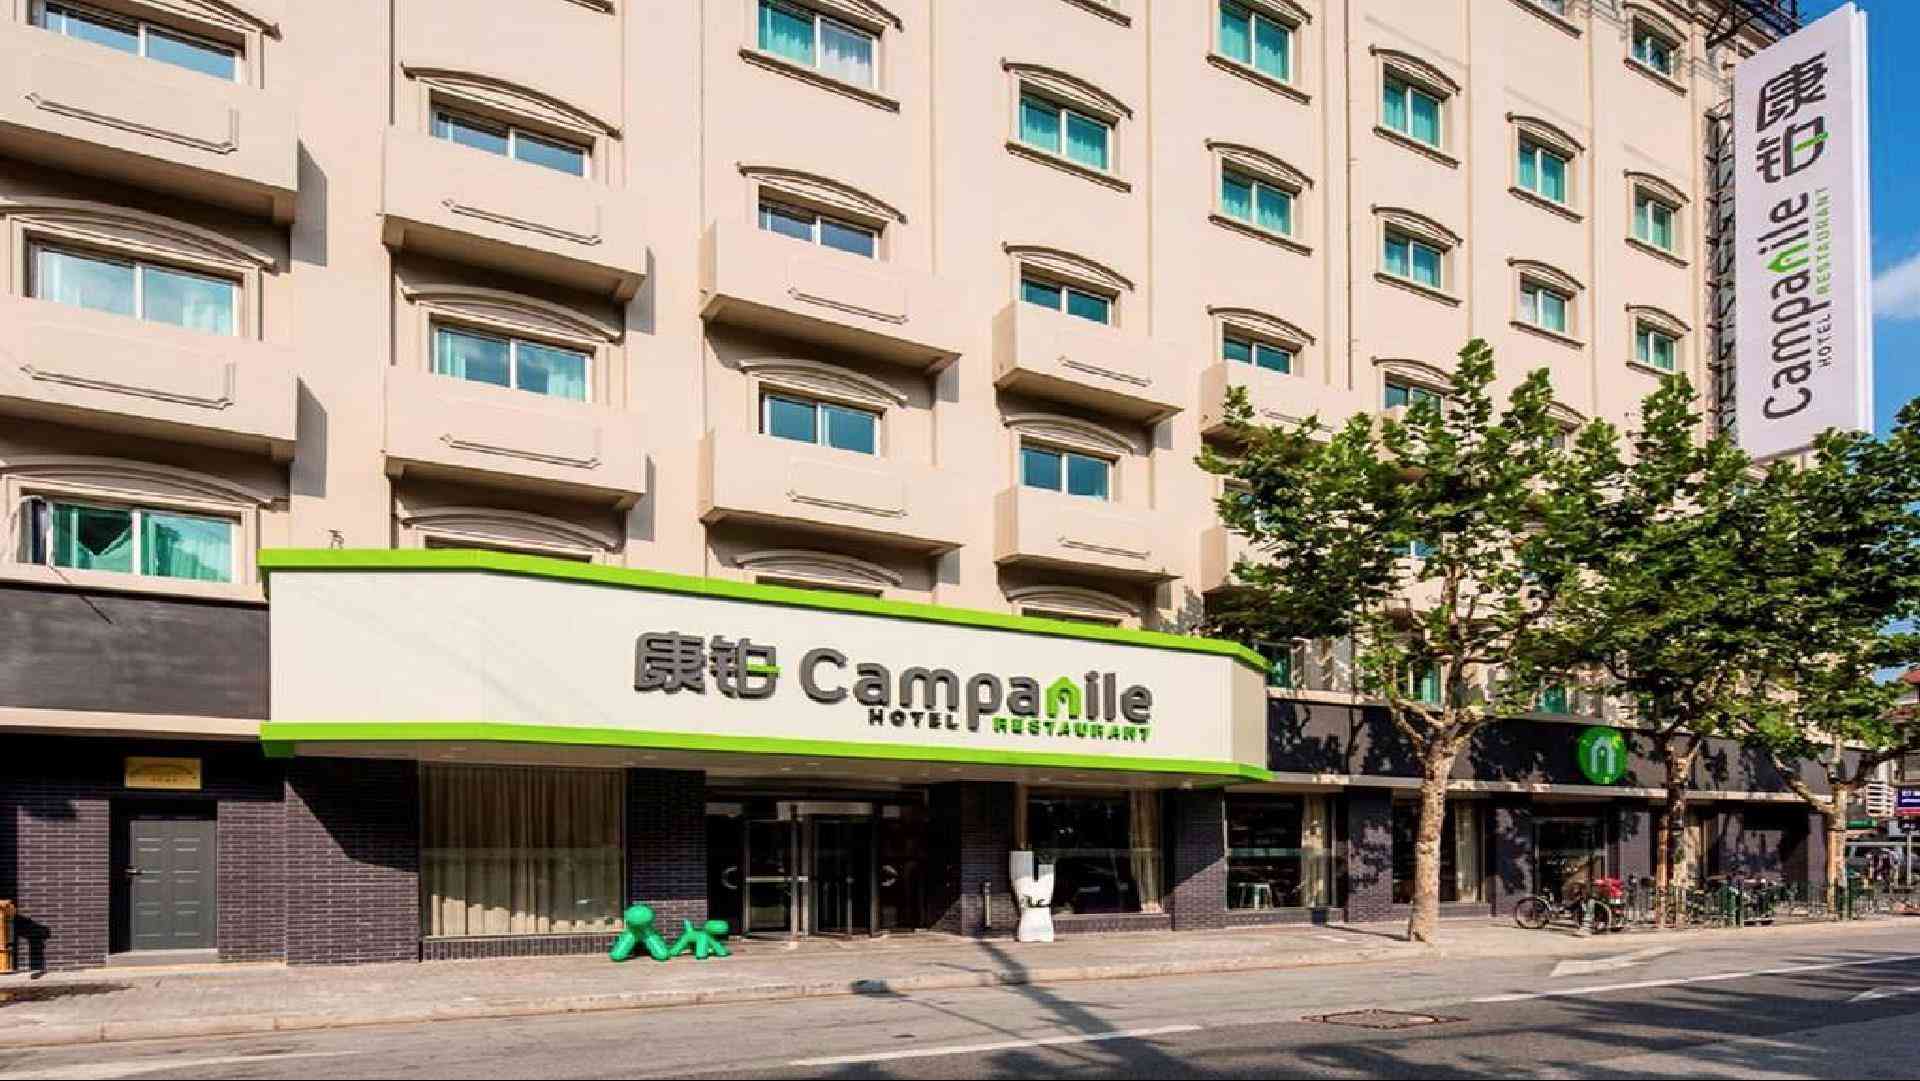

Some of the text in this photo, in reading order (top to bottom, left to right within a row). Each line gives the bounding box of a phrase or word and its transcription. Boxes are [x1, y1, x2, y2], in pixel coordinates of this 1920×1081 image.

[1757, 192, 1831, 419] Campanile
[1815, 187, 1832, 369] HOTEL RESTAURANT
[800, 648, 1153, 732] Campanile
[868, 708, 1150, 742] HOTEL RESTAURANT
